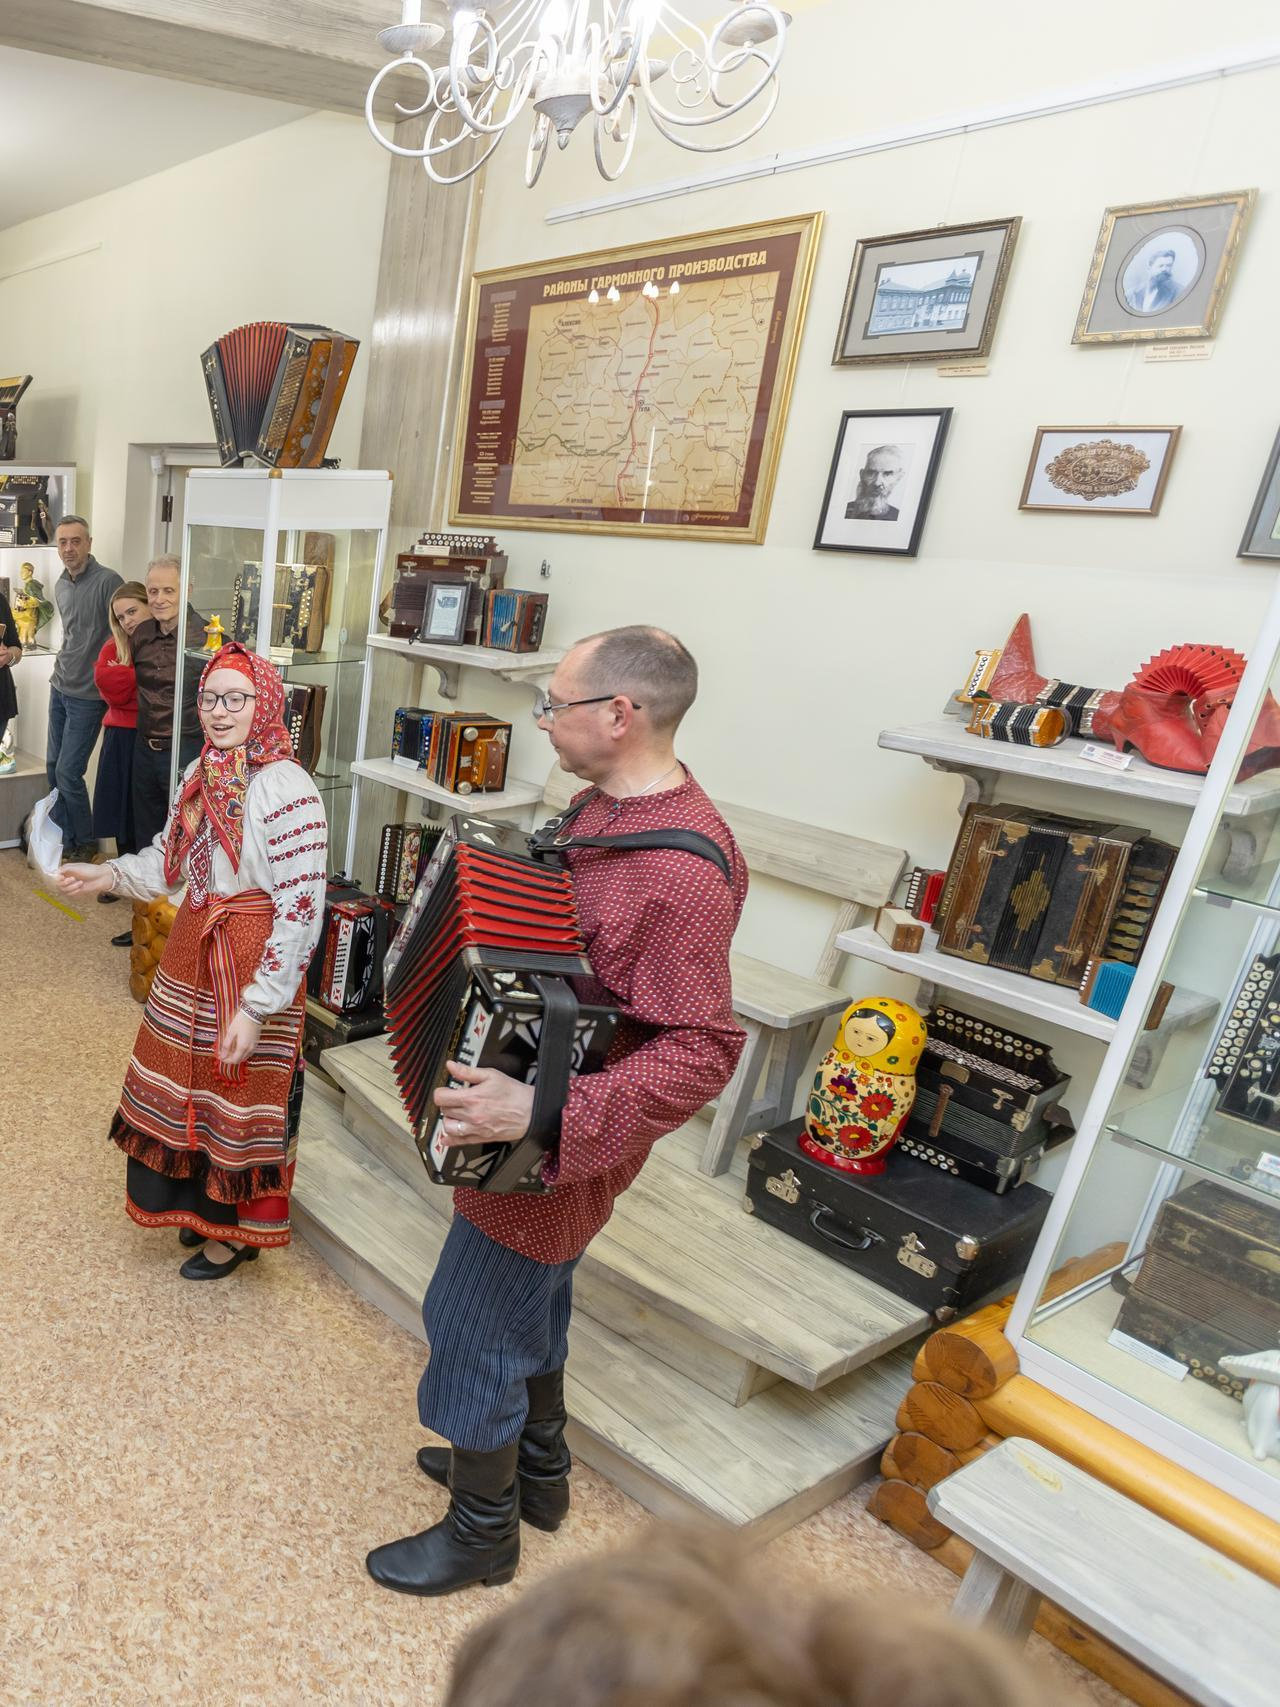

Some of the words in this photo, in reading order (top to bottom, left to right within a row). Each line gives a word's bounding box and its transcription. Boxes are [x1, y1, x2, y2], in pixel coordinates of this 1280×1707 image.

[543, 278, 589, 297] РАЙОНЫ
[591, 267, 665, 290] ГАРМОННОГО
[668, 250, 767, 279] ПРОИЗВОДСТВА
